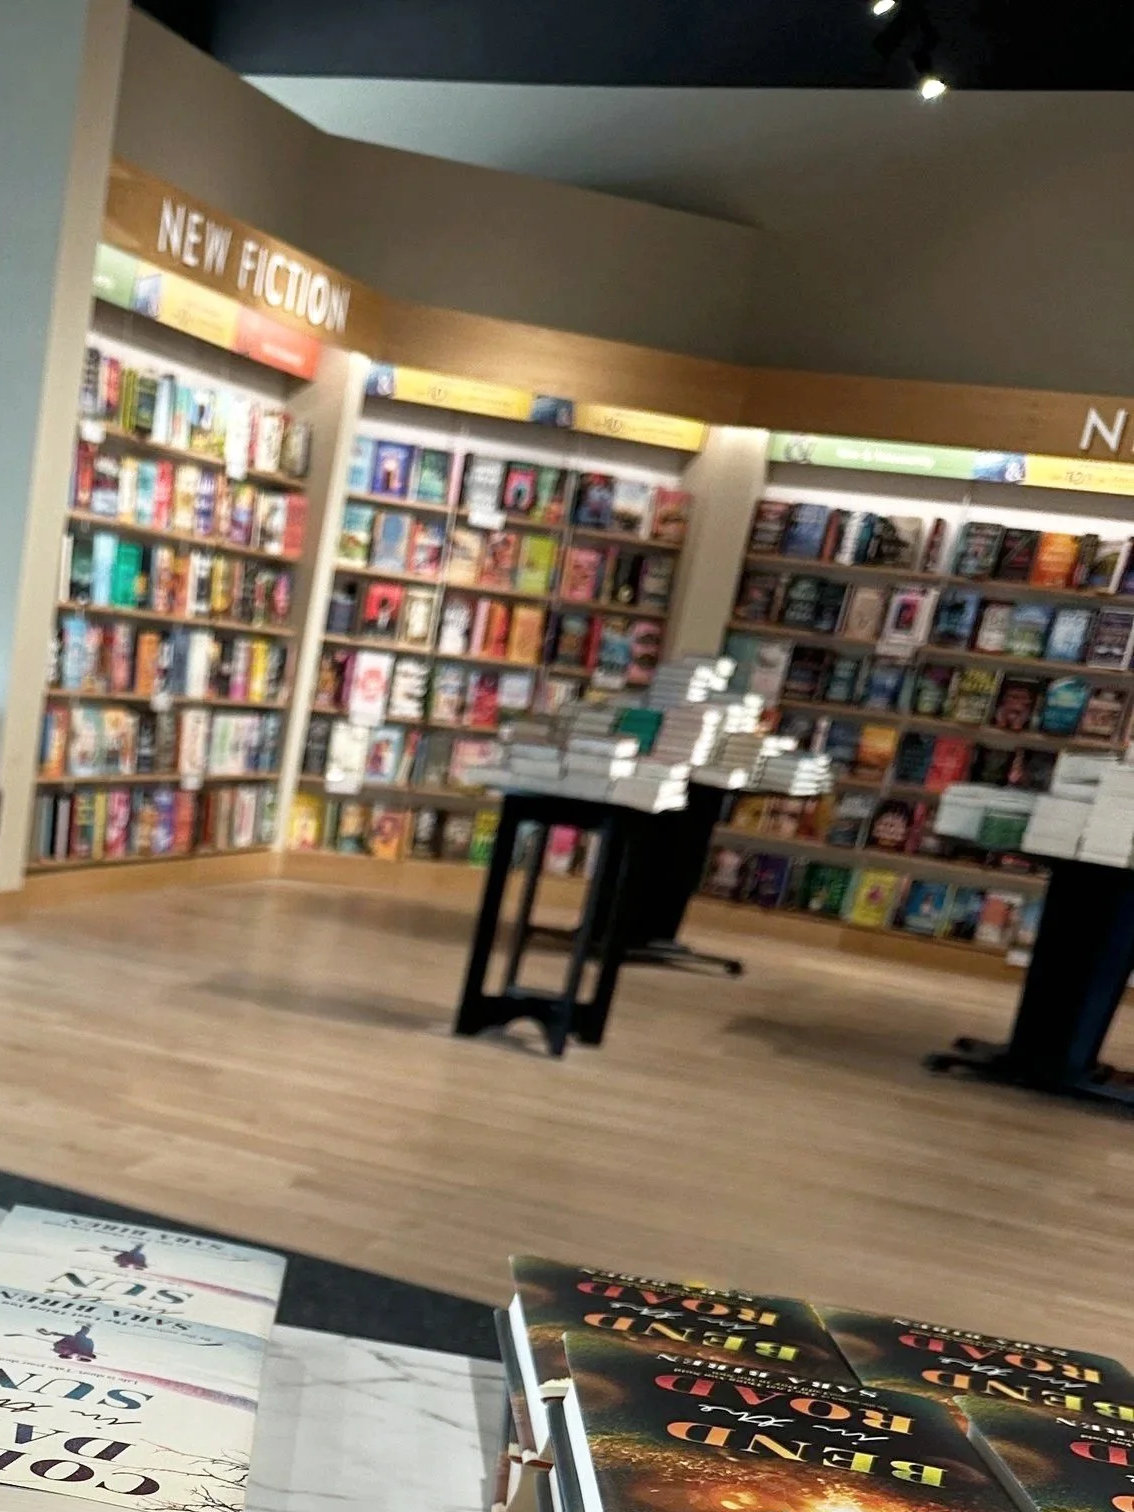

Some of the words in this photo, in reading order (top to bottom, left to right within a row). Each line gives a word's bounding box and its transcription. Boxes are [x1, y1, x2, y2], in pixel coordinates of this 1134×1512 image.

[157, 196, 233, 277] NEW
[237, 239, 352, 333] FICTION
[44, 1272, 194, 1306] SUN
[575, 1281, 780, 1328] ROAD
[111, 1307, 192, 1332] SARA
[584, 1312, 799, 1362] BEND
[897, 1333, 1104, 1385] ROAD
[653, 1373, 915, 1436] ROAD
[697, 1403, 795, 1428] the
[921, 1369, 1134, 1421] BEND
[666, 1419, 947, 1489] BEND
[811, 1423, 890, 1446] in
